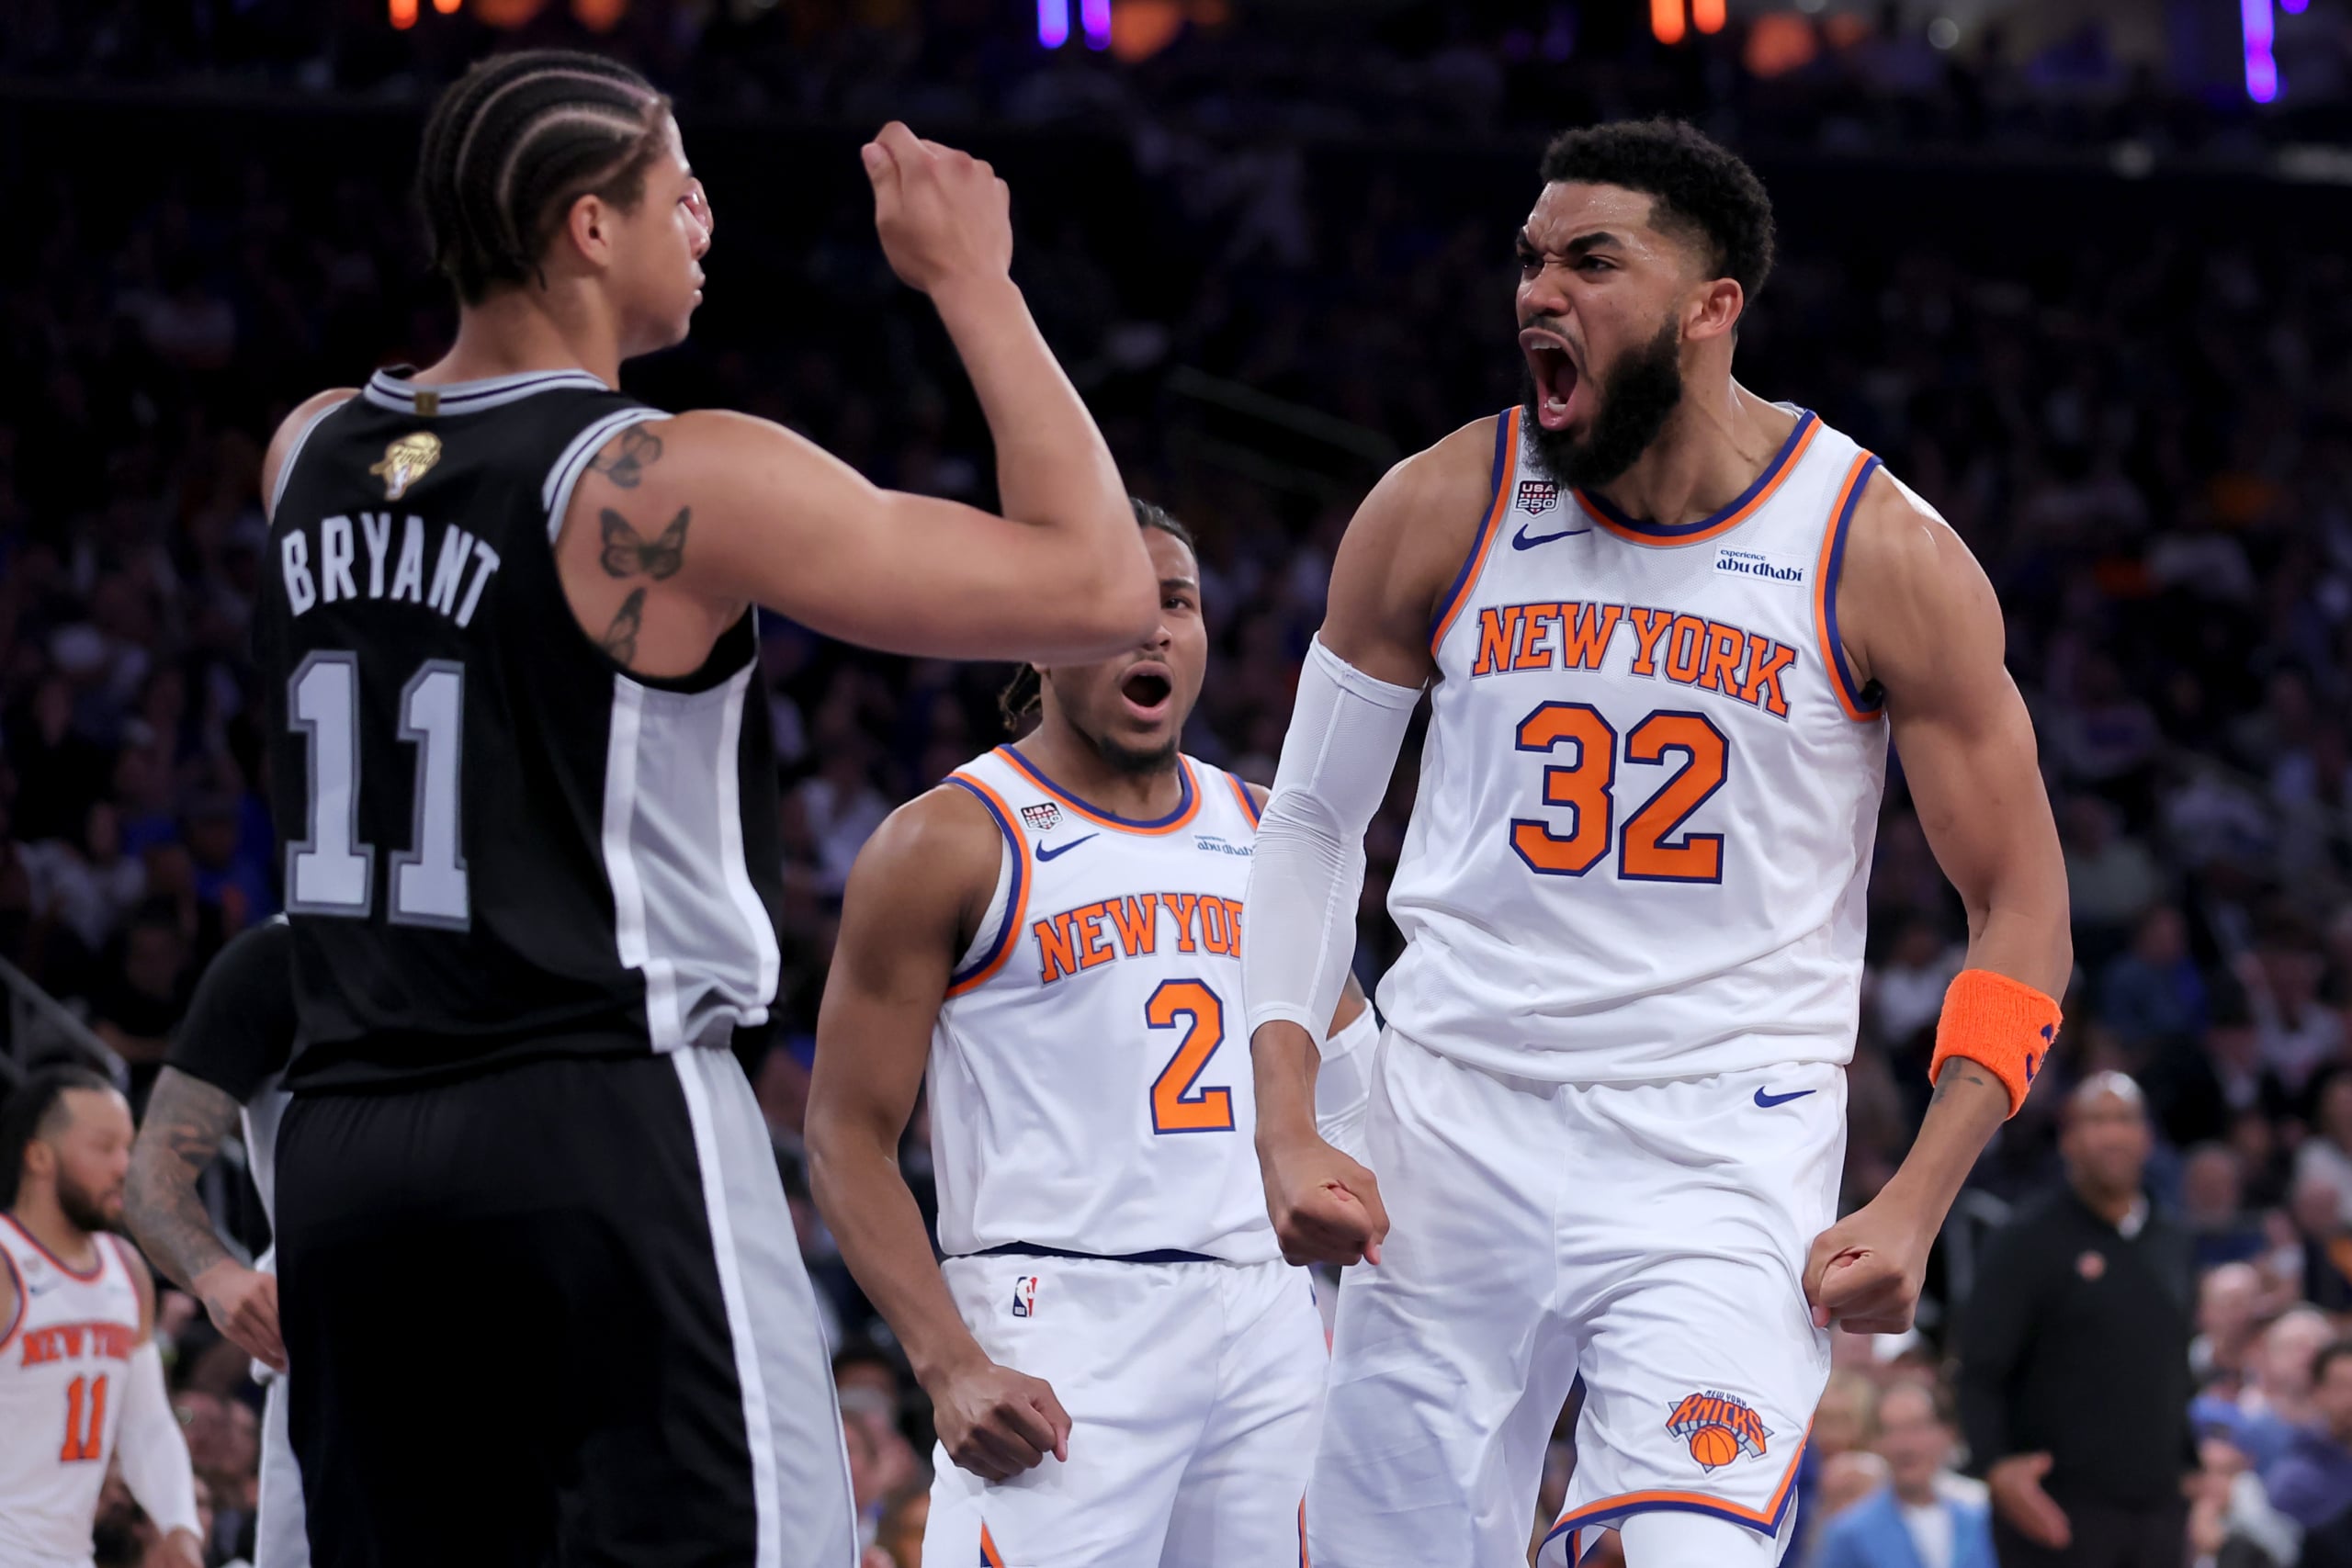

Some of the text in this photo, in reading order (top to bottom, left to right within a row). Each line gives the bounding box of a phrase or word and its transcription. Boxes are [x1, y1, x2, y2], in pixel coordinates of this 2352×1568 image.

[1517, 499, 1555, 509] 250
[1521, 483, 1555, 493] USA
[281, 512, 502, 628] BRYANT
[1716, 558, 1750, 573] abu
[1720, 549, 1766, 561] experience
[1471, 601, 1798, 722] NEW YORK
[285, 649, 471, 933] 11
[1510, 700, 1730, 885] 32
[1197, 840, 1253, 856] abu dhab
[1031, 891, 1244, 987] NEW YOR
[1145, 977, 1236, 1135] 2
[21, 1323, 85, 1368] NEW
[60, 1373, 109, 1462] 11
[1666, 1393, 1767, 1455] KNICKS
[1704, 1389, 1747, 1408] NEW YORK
